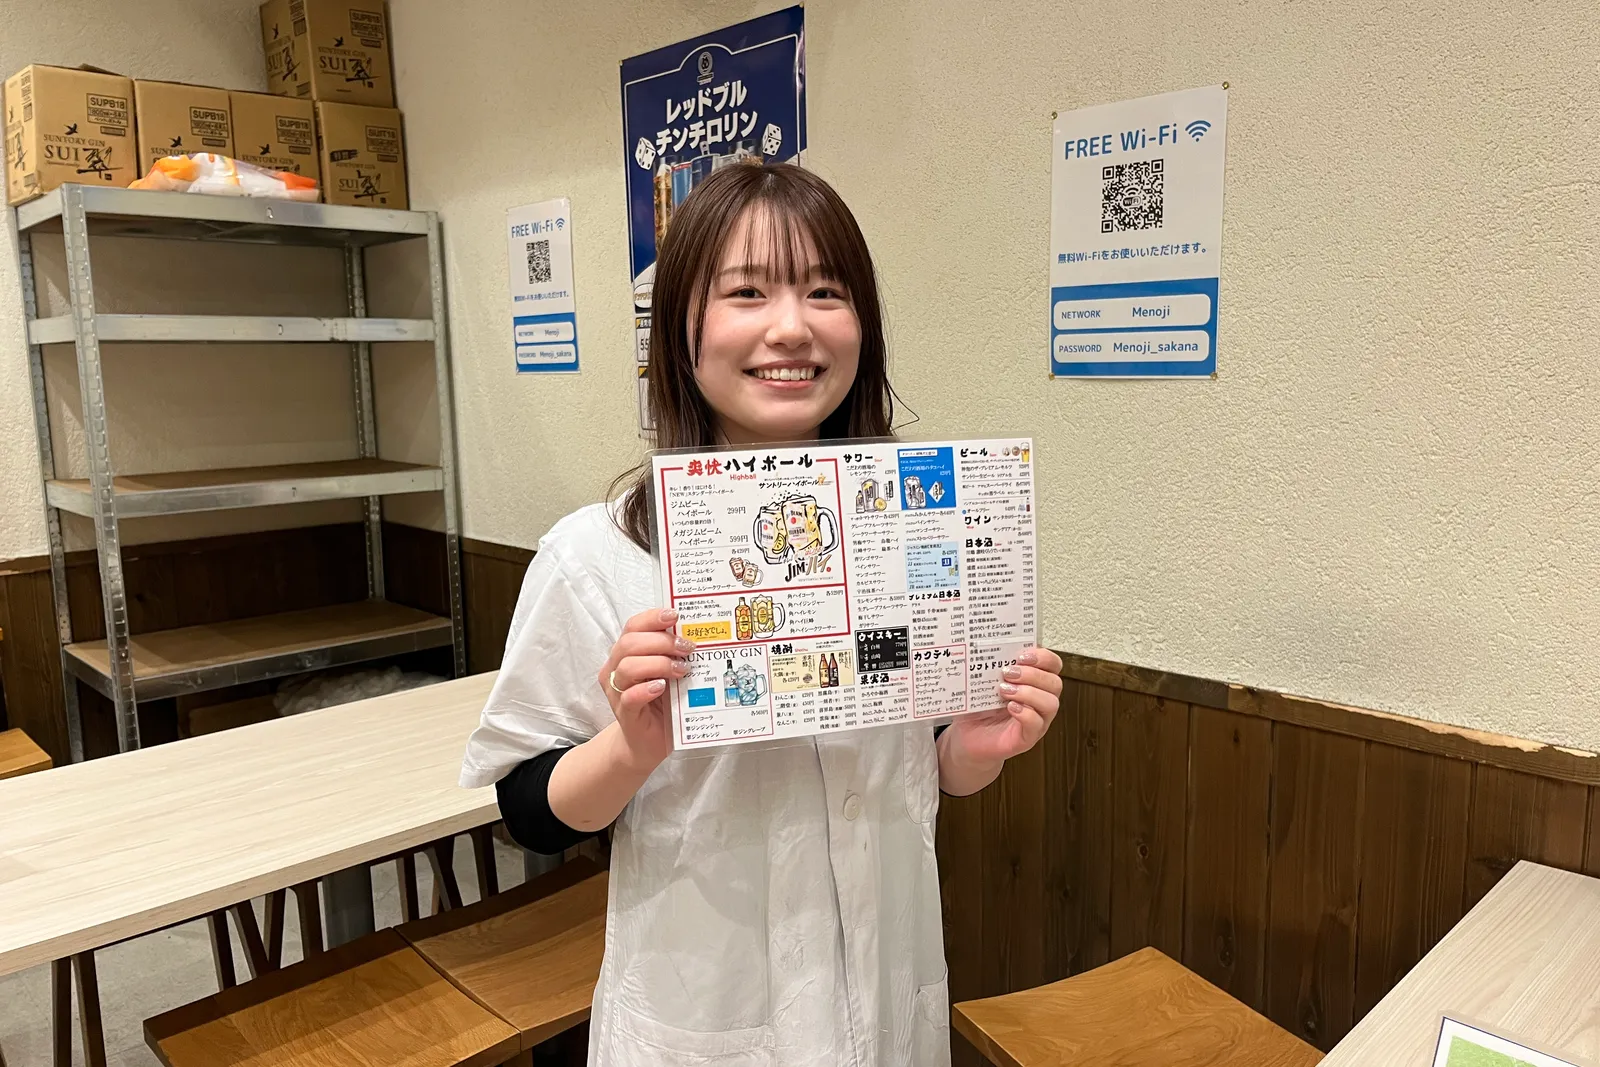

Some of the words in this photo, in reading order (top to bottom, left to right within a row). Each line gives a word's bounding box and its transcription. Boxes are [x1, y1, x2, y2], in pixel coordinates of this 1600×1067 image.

[319, 55, 347, 71] SUI
[90, 97, 125, 109] SUPB18
[666, 80, 747, 124] レッドブル
[193, 110, 225, 121] SUPB18
[43, 134, 86, 145] SUNTORY
[656, 111, 758, 156] チンチロリン
[1065, 135, 1112, 160] FREE
[1120, 123, 1177, 151] Wi-Fi
[44, 144, 80, 161] SUI
[339, 178, 359, 190] SUI
[511, 224, 529, 238] FREE
[531, 219, 553, 235] Wi-Fi
[1057, 242, 1207, 264] 無料Wi-Fiをお使いいただけます。
[1061, 310, 1101, 319] NETWORK
[1132, 306, 1170, 319] Menoji
[544, 329, 560, 337] Menoji
[1059, 344, 1102, 353] PASSWORD
[1113, 341, 1199, 354] Menoji_sakana
[843, 453, 873, 463] サワー
[960, 447, 988, 458] ビール
[687, 453, 813, 476] 爽快ハイボール
[759, 480, 819, 489] サントリーハイボール
[671, 500, 706, 509] ジムビーム
[677, 509, 712, 517] ハイボール
[726, 506, 746, 514] 299円
[965, 515, 991, 525] ワイン
[673, 528, 722, 537] メガジムビーム
[679, 537, 715, 546] ハイボール
[729, 535, 748, 543] 599円
[966, 537, 993, 548] 日本酒
[675, 550, 713, 558] ジムビームコーラ
[908, 590, 960, 601] プレミアム日本酒
[680, 612, 712, 620] 角ハイボール
[858, 630, 901, 642] ウイスキー
[740, 647, 762, 657] GIN
[771, 643, 793, 655] 焼酎
[914, 648, 951, 661] カクテル
[970, 659, 1017, 671] ソフトドリンク
[860, 673, 889, 685] 果実酒
